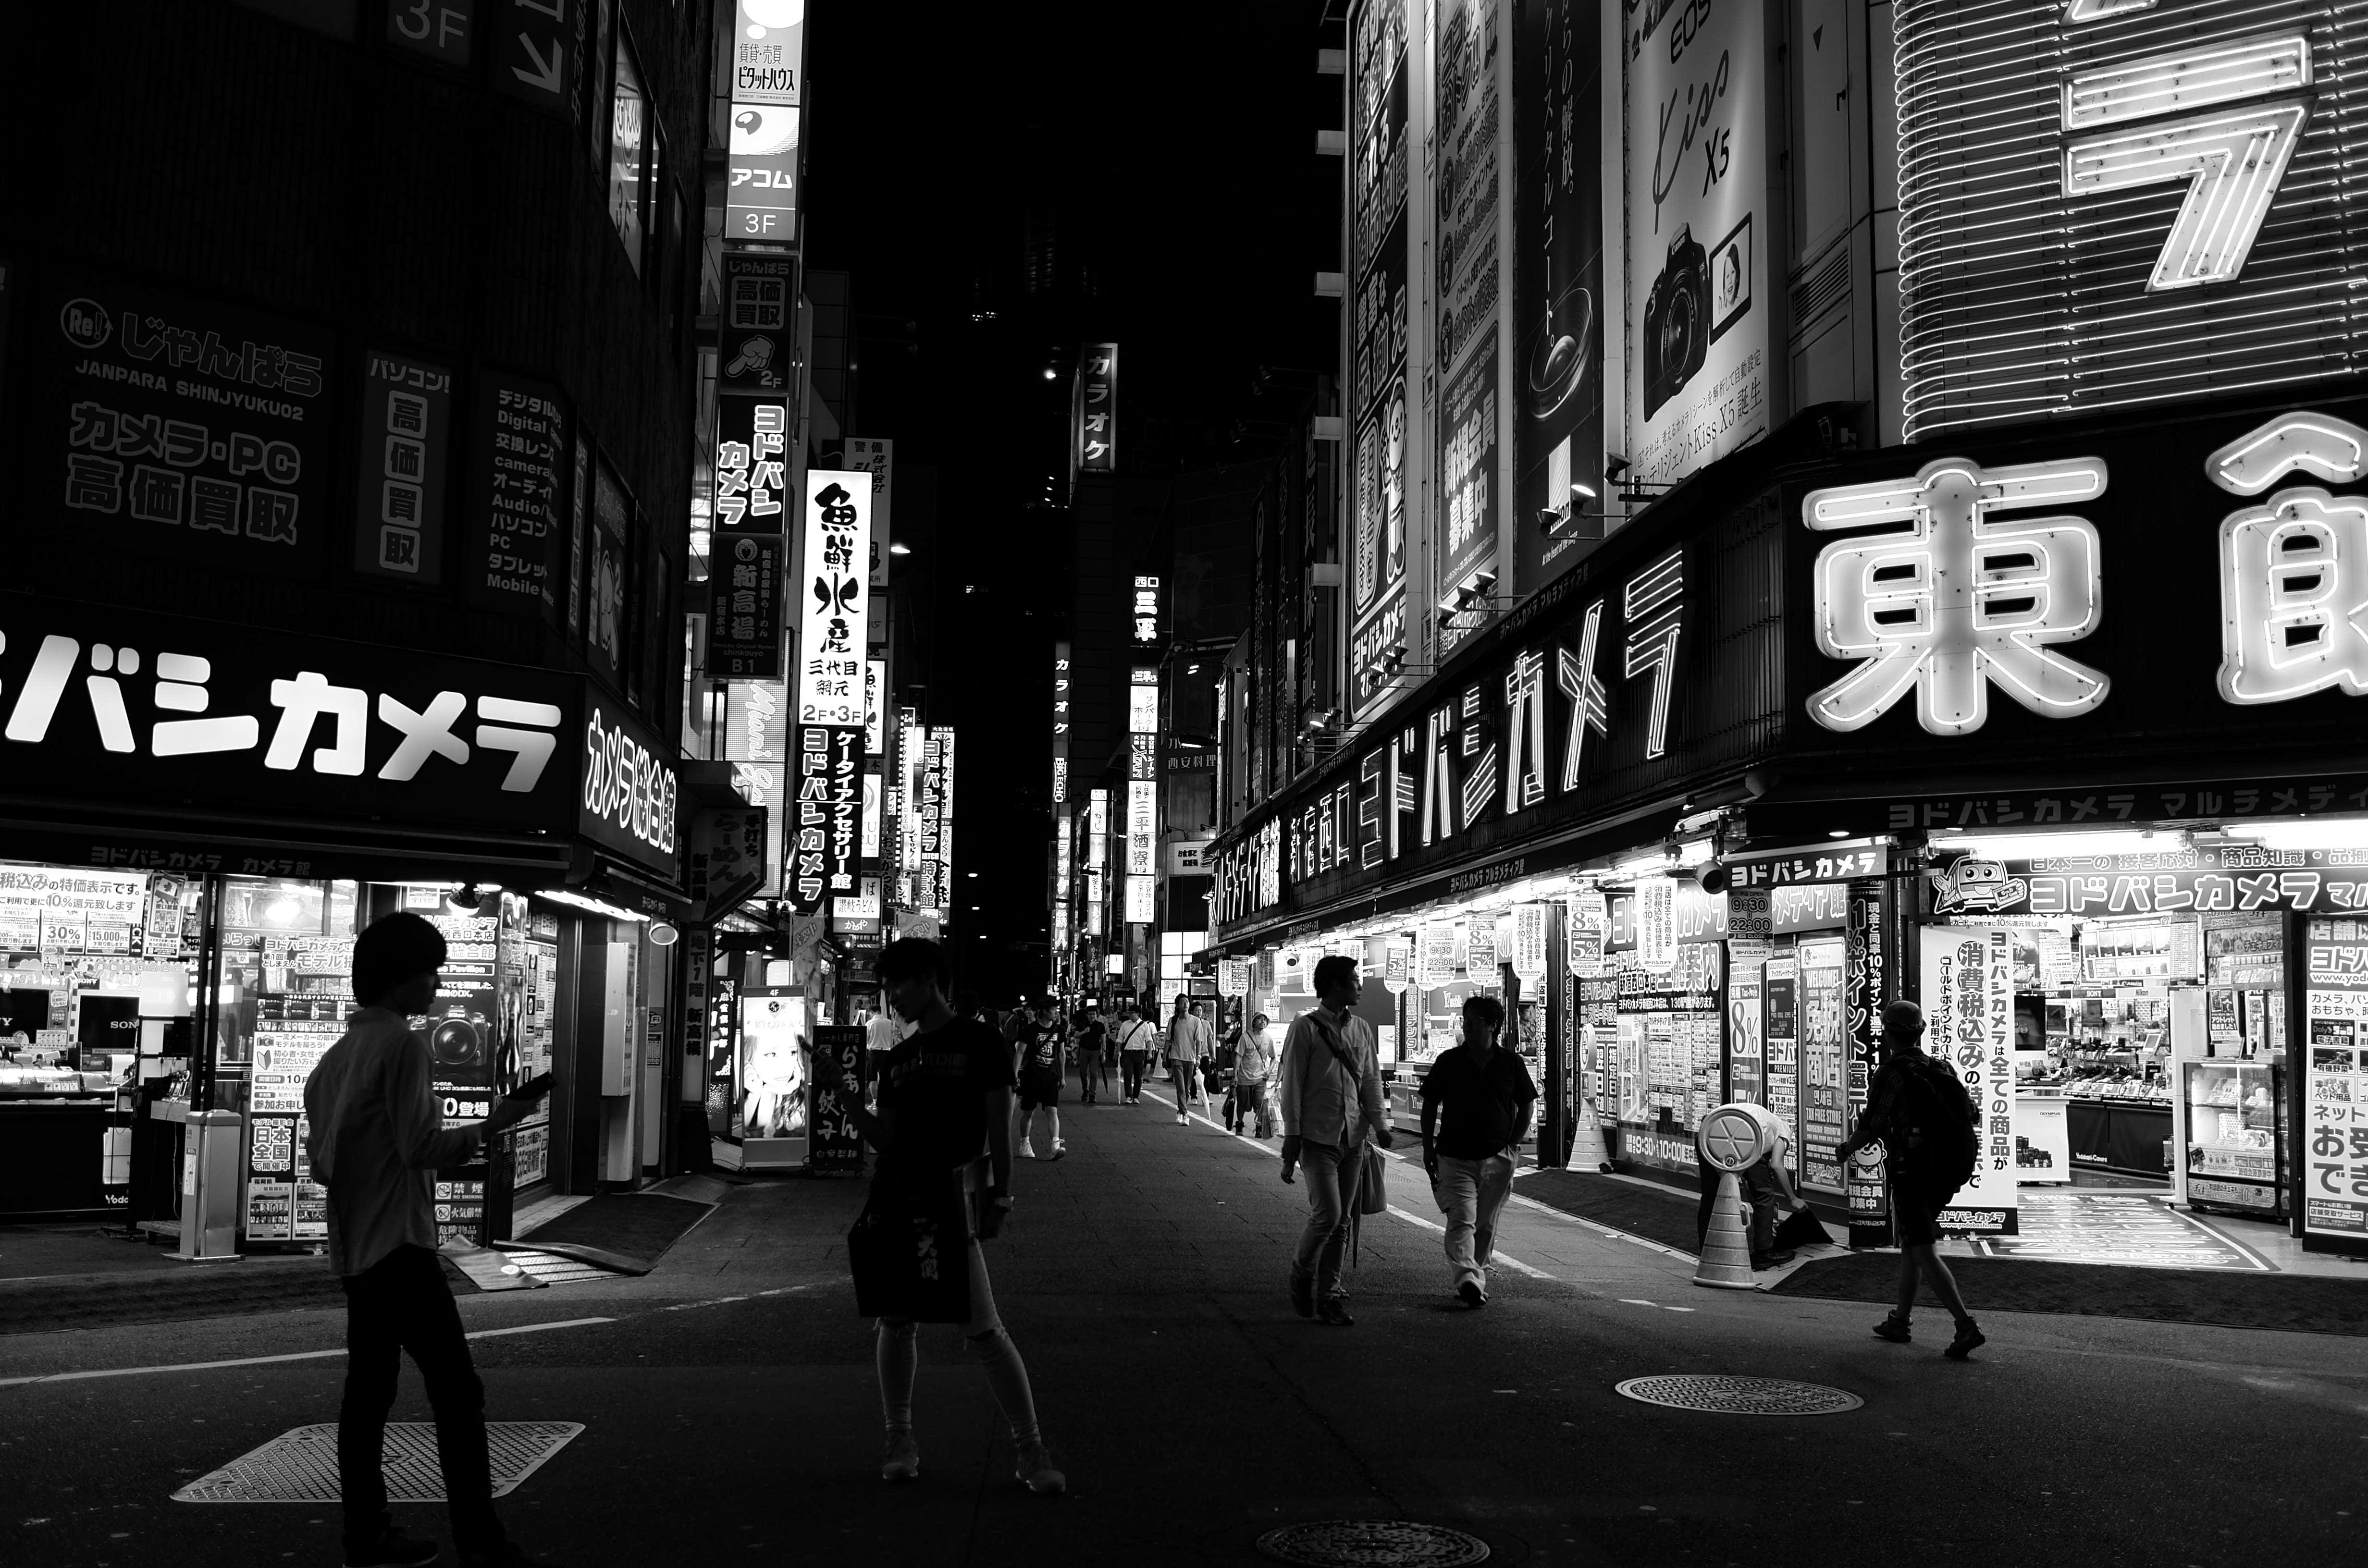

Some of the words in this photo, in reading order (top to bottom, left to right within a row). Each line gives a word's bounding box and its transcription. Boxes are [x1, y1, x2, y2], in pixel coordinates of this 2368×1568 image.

[1671, 0, 1711, 64] EOS
[740, 44, 782, 64] 賃貸・売買
[739, 66, 795, 91] ピタットハウス
[1653, 49, 1729, 235] Kiss
[1702, 126, 1730, 198] X5
[2060, 0, 2315, 293] ラ
[731, 168, 792, 189] アコム
[1543, 0, 1554, 346] クリスタルコート。
[745, 213, 776, 233] 3F
[1671, 235, 1686, 256] Canon
[736, 280, 780, 301] 高価
[736, 304, 779, 325] 買取
[121, 311, 321, 398] じゃんぱら
[370, 358, 450, 394] パソコン!
[760, 370, 782, 388] 2F
[75, 359, 168, 392] JANPARA
[175, 380, 304, 421] SHINJYUKU02
[1084, 356, 1110, 460] カラオケ
[1693, 423, 1717, 455] Kiss
[1719, 400, 1735, 435] X5
[1737, 377, 1763, 423] 誕生
[497, 409, 547, 434] Digital
[69, 401, 302, 485] カメラ・PC
[1444, 388, 1495, 499] 新規会員
[750, 404, 785, 516] ヨドバシ
[379, 389, 429, 574] 高価買取
[717, 441, 750, 524] カメラ
[65, 453, 300, 546] 高価買取
[1449, 467, 1488, 557] 募集中
[491, 512, 548, 538] パソコン
[490, 533, 511, 550] PC
[487, 573, 540, 596] Mobile
[1135, 576, 1159, 588] 西口
[1353, 597, 1406, 676] ヨドバシカメラ
[732, 659, 754, 673] B1
[808, 659, 859, 676] 三代目
[1054, 659, 1069, 734] カラオケ
[0, 630, 561, 793] バシカメラ
[1134, 707, 1144, 725] ホール
[1145, 696, 1155, 725] サンパーク
[1361, 550, 1683, 870] ヨドバシカメラ
[1168, 755, 1216, 769] 西安料理
[585, 708, 676, 854] カメラ総合館
[921, 740, 941, 852] ヨドバシカメラ
[798, 728, 829, 901] ヨドバシカメラ
[830, 731, 856, 890] ケータイアクセサリー館
[1889, 794, 2135, 828] ヨドバシカメラ
[90, 845, 223, 870] ヨドバシカメラ
[242, 857, 312, 876] カメラ館
[1732, 852, 1876, 887] ヨドバシカメラ
[920, 860, 937, 908] 時計館
[2029, 871, 2322, 913] ヨドバシカメラ
[1732, 897, 1768, 912] 9:30
[48, 926, 80, 940] 30%
[1571, 912, 1600, 931] 8%
[1728, 918, 1773, 932] 22:00
[263, 952, 284, 961] 第1回
[1572, 941, 1599, 958] 5%
[449, 965, 485, 974] Pavilion
[1940, 955, 1953, 1061] ゴールドポイントカード
[110, 1020, 139, 1029] SON
[1731, 1001, 1758, 1055] 8%
[1989, 932, 2010, 1170] ヨドバシカメラは全ての商品が
[2317, 1035, 2349, 1045] 電子書籍
[1959, 942, 1986, 1188] 消費税込みの特で
[2317, 1064, 2349, 1073] 有機野菜
[2315, 1093, 2351, 1102] ペット用品
[1806, 1107, 1814, 1121] TAX
[1815, 1108, 1826, 1123] FREE
[1826, 1109, 1841, 1124] STORE
[254, 1126, 292, 1145] 日本
[252, 1144, 292, 1162] 全国
[252, 1162, 291, 1172] で開催中
[1806, 1161, 1841, 1179] ヨドバシカメラ
[453, 1183, 483, 1194] 禁煙
[451, 1207, 482, 1219] 火気厳禁
[2309, 1208, 2363, 1220] 店舗受取サービス
[438, 1225, 477, 1236] 危険物品
[1939, 1222, 2003, 1230] www.yodobashi.com
